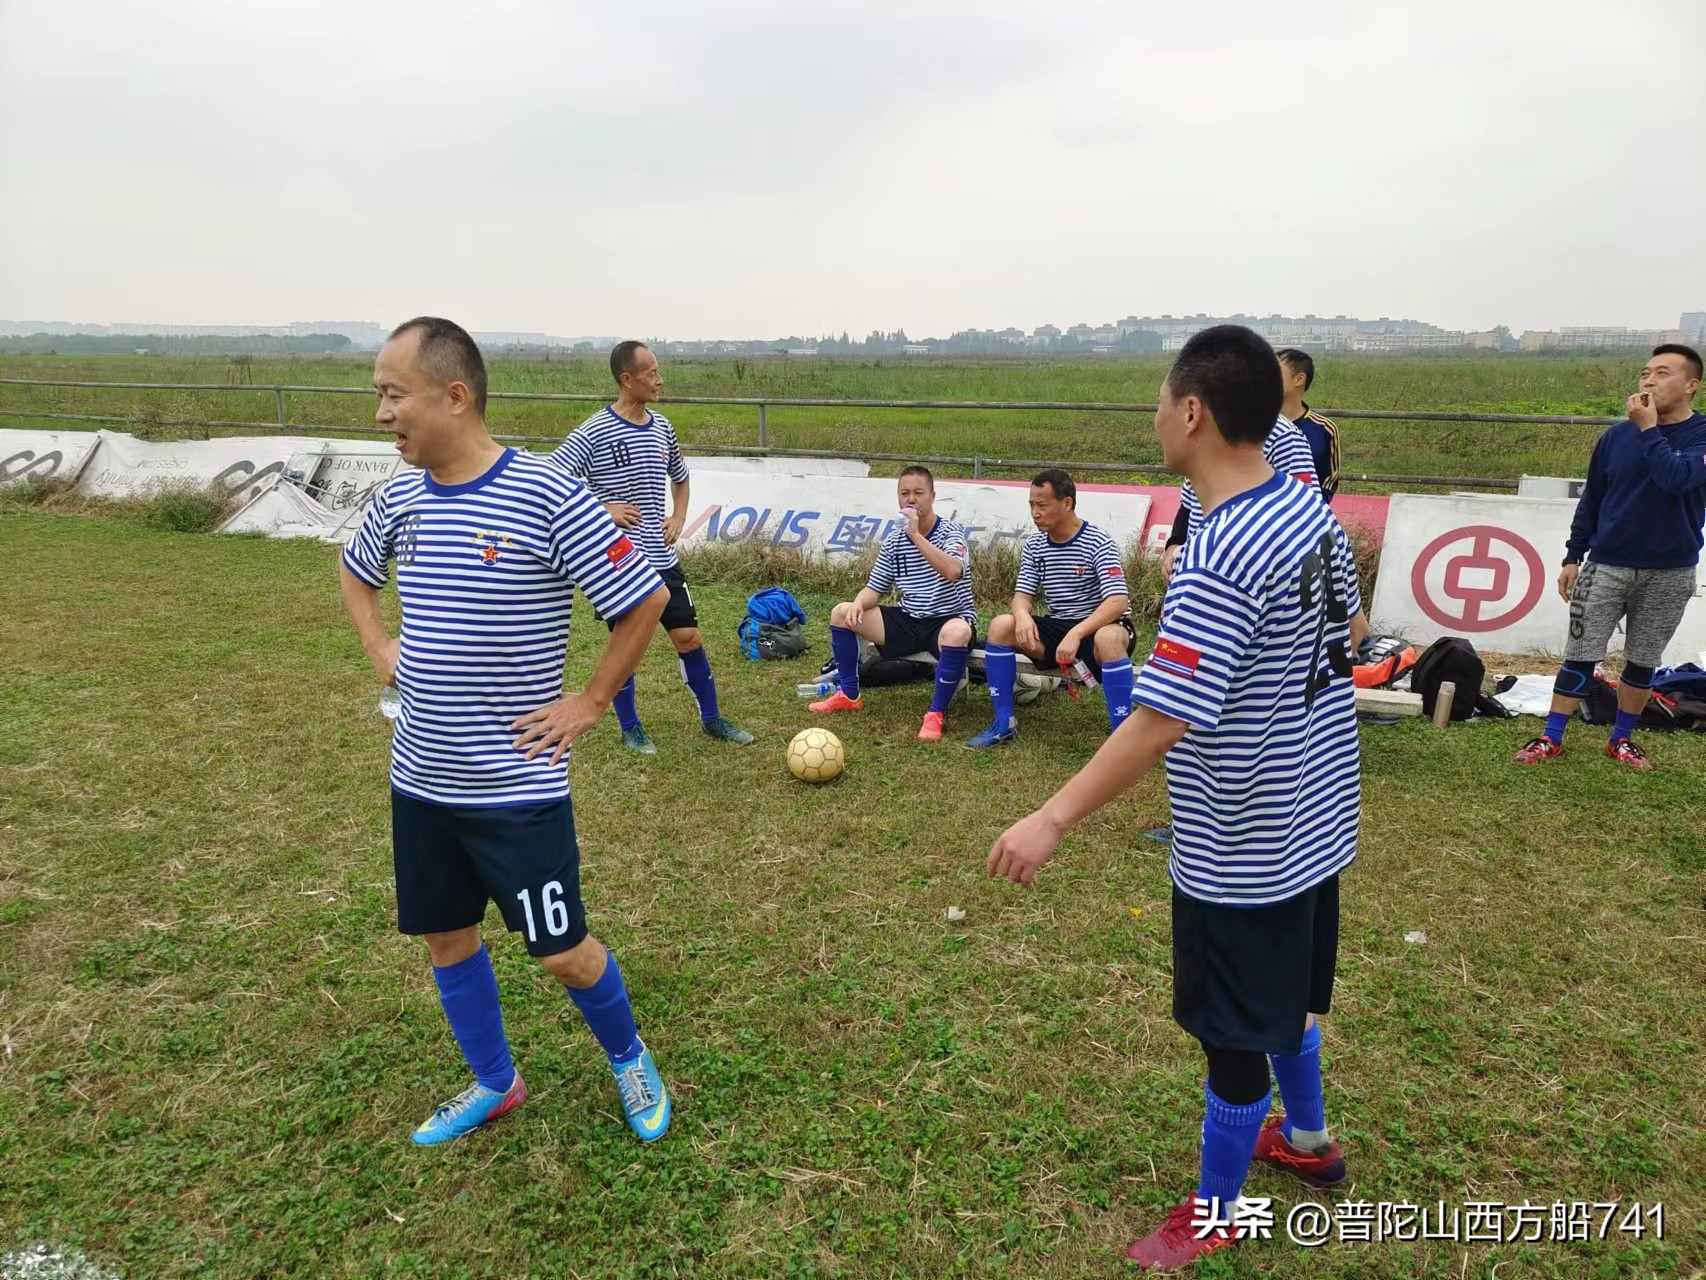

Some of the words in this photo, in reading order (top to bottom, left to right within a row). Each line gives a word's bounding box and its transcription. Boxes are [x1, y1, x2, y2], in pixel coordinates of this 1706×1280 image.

[334, 459, 352, 471] OF
[353, 460, 389, 474] BANK
[1569, 561, 1597, 641] GUESS
[516, 880, 569, 942] 16
